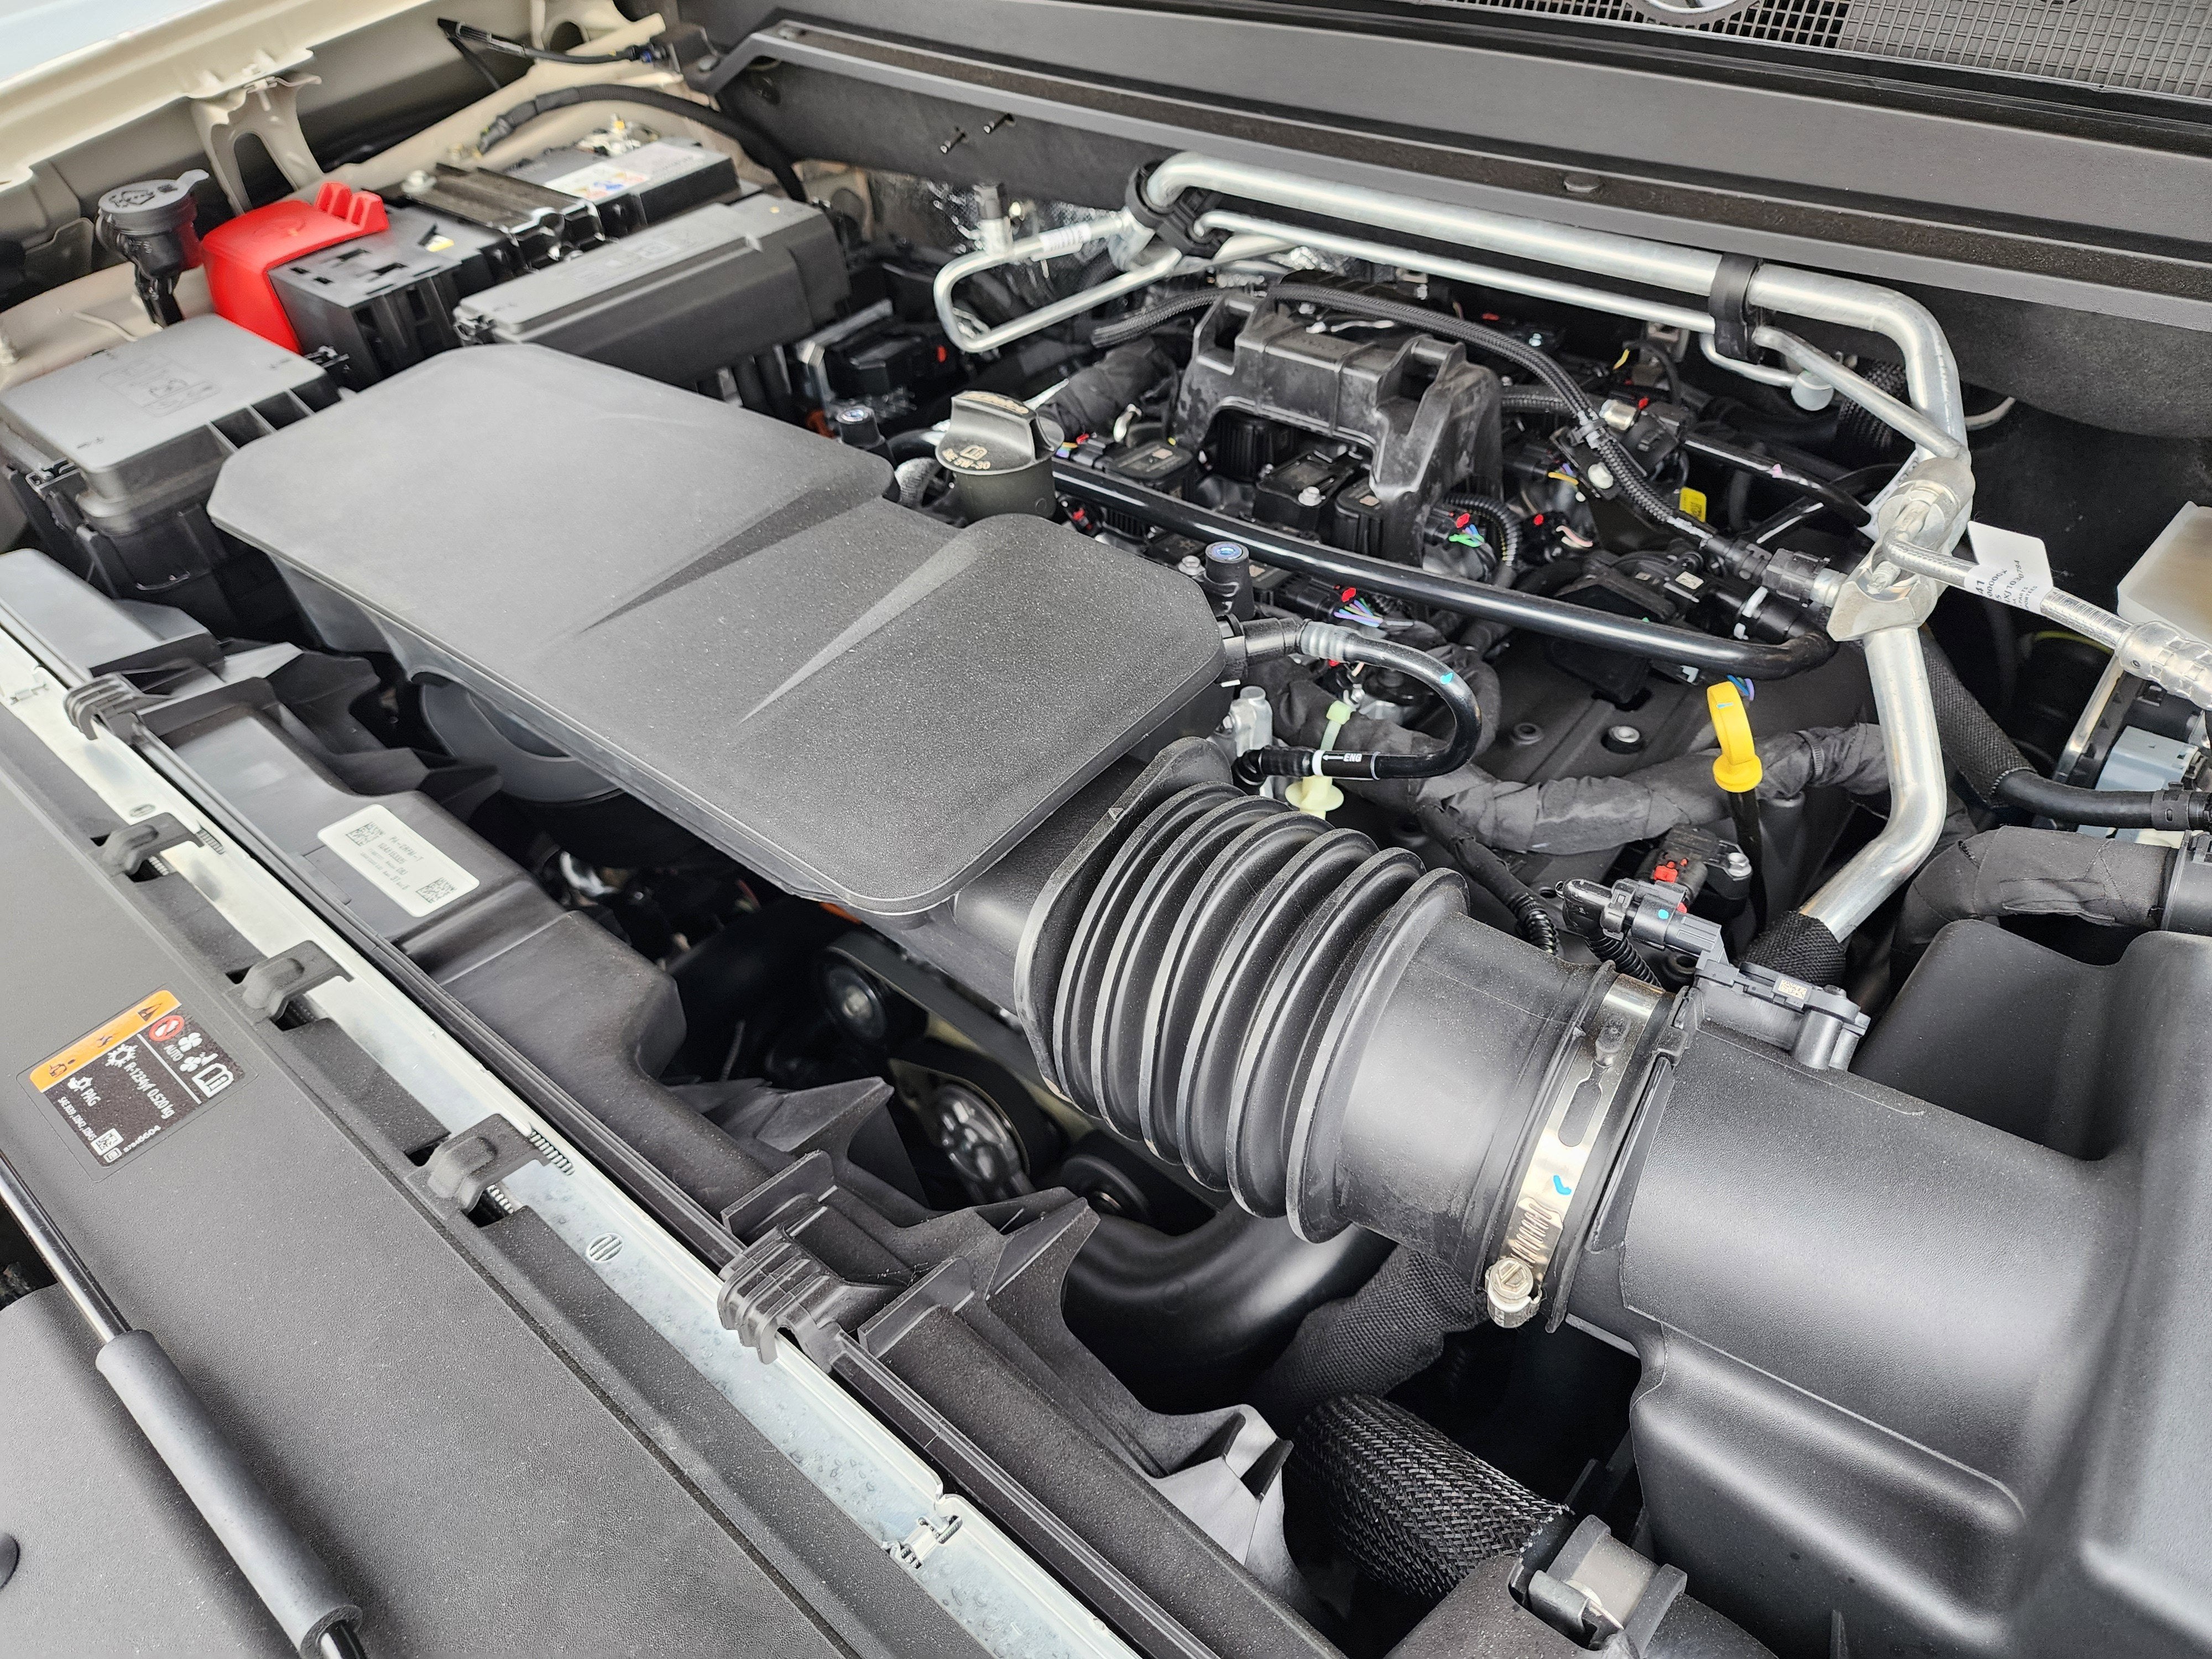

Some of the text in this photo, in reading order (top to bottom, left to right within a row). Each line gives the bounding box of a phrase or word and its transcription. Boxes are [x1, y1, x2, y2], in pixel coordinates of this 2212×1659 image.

[953, 457, 990, 469] 5W-30
[1343, 753, 1363, 763] ENG
[164, 1045, 184, 1062] AUTO
[80, 1088, 101, 1107] PAG
[161, 1104, 175, 1119] kg
